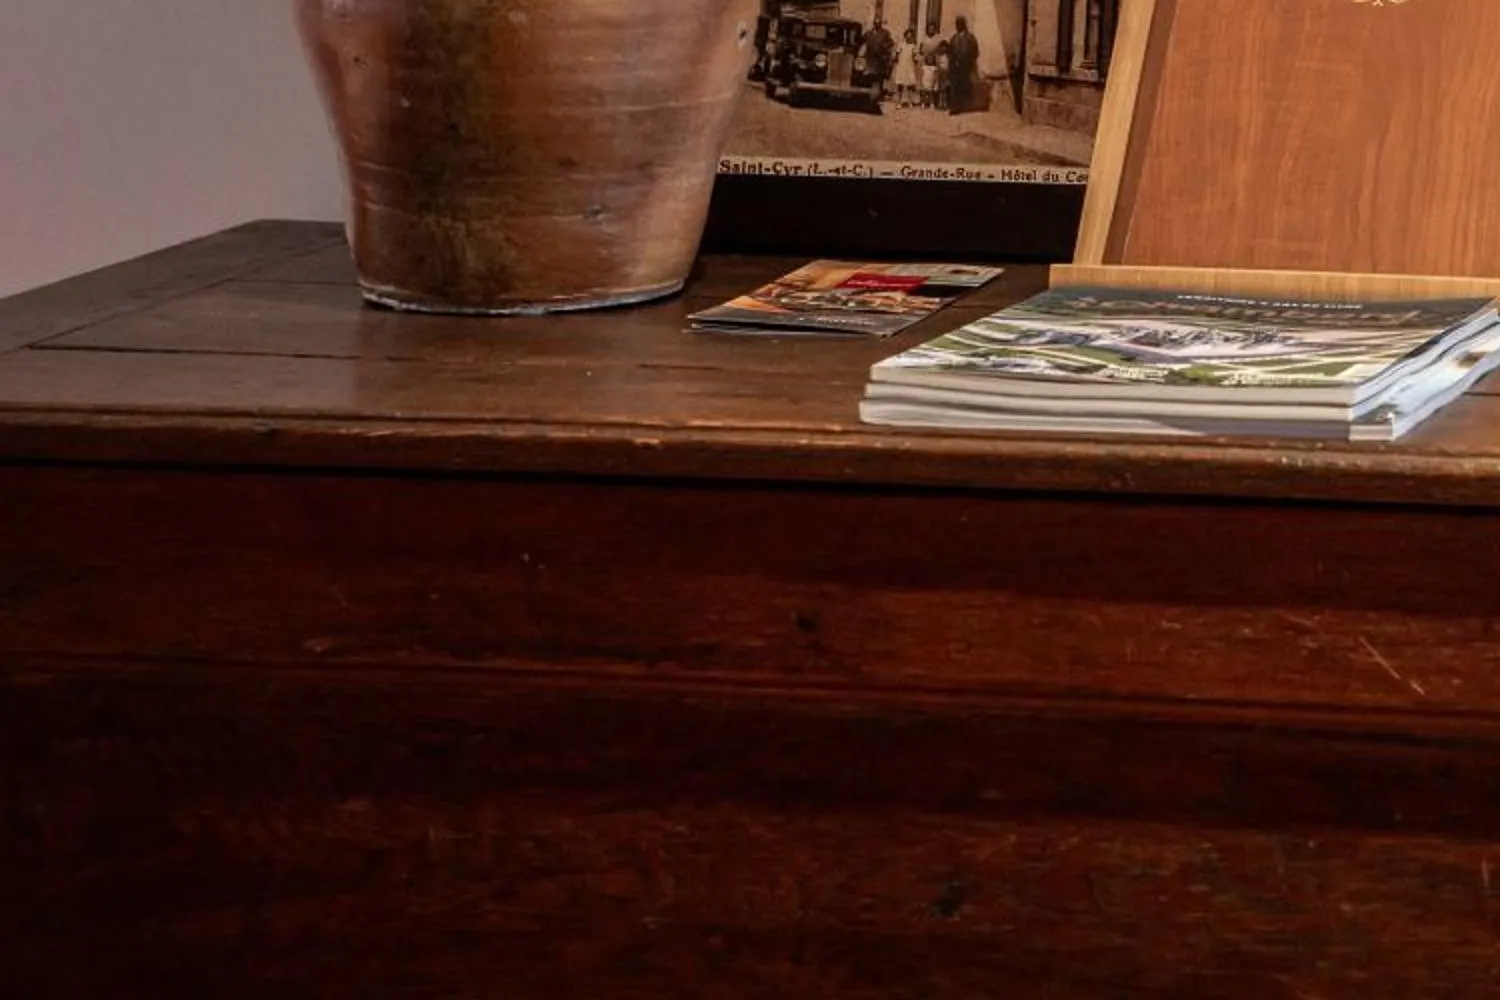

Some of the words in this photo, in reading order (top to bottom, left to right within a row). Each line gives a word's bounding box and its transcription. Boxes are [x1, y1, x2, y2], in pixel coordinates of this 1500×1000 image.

[719, 159, 803, 176] Saint-Cyr
[1001, 168, 1037, 181] Hôtel
[1041, 170, 1060, 182] du
